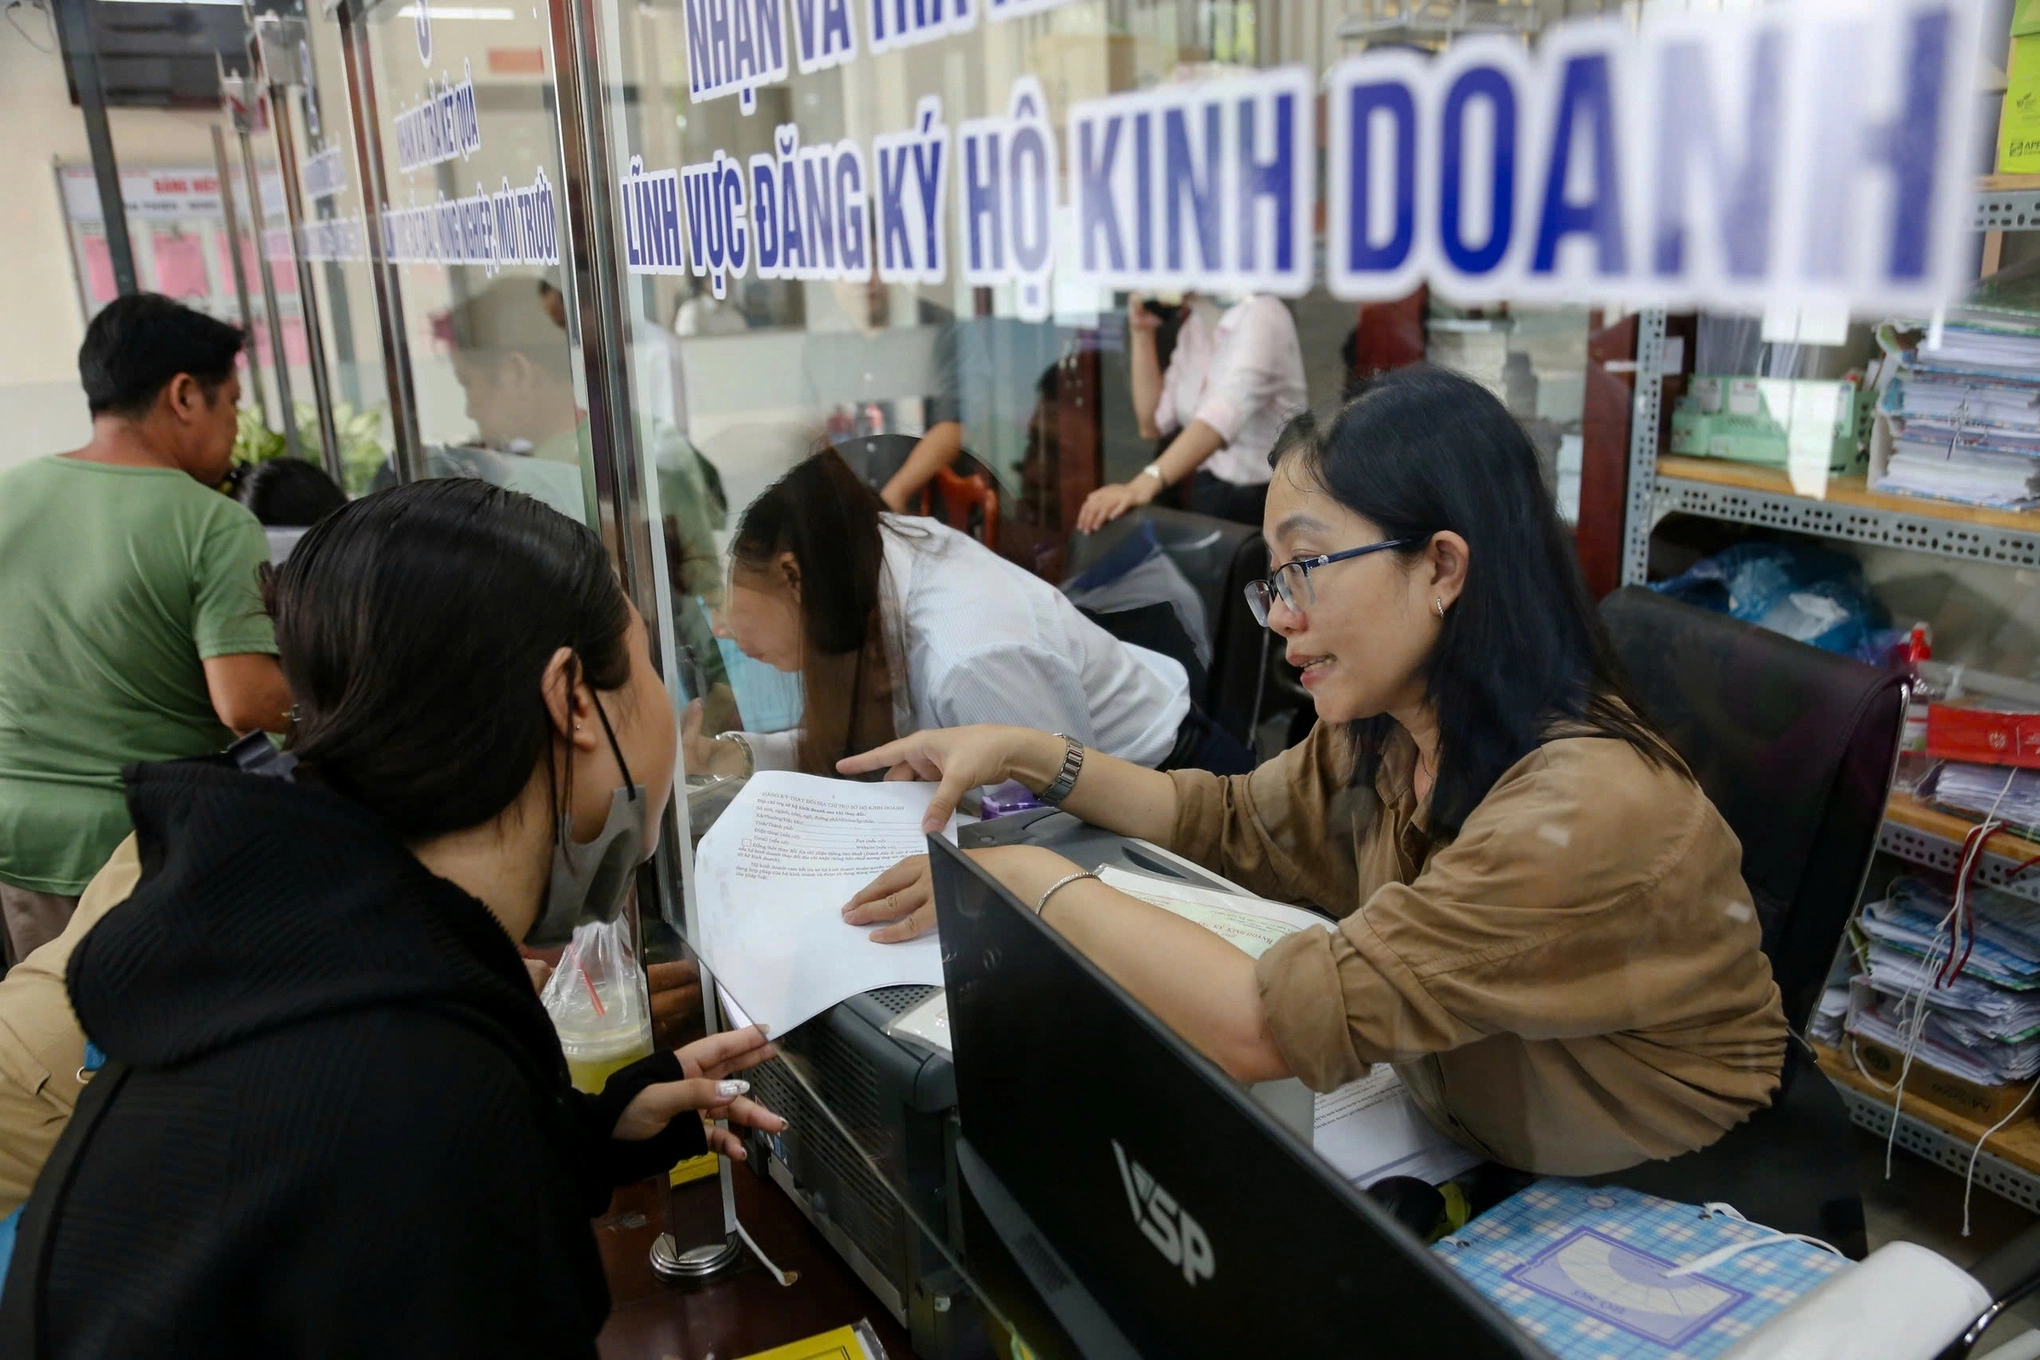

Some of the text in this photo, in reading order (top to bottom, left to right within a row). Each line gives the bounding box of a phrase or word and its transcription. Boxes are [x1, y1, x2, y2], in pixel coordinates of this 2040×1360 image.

[456, 63, 479, 156] QUẢ
[621, 7, 1950, 305] LĨNH VỰC ĐĂNG KÝ HỘ KINH DOANH
[494, 182, 520, 259] MÔI
